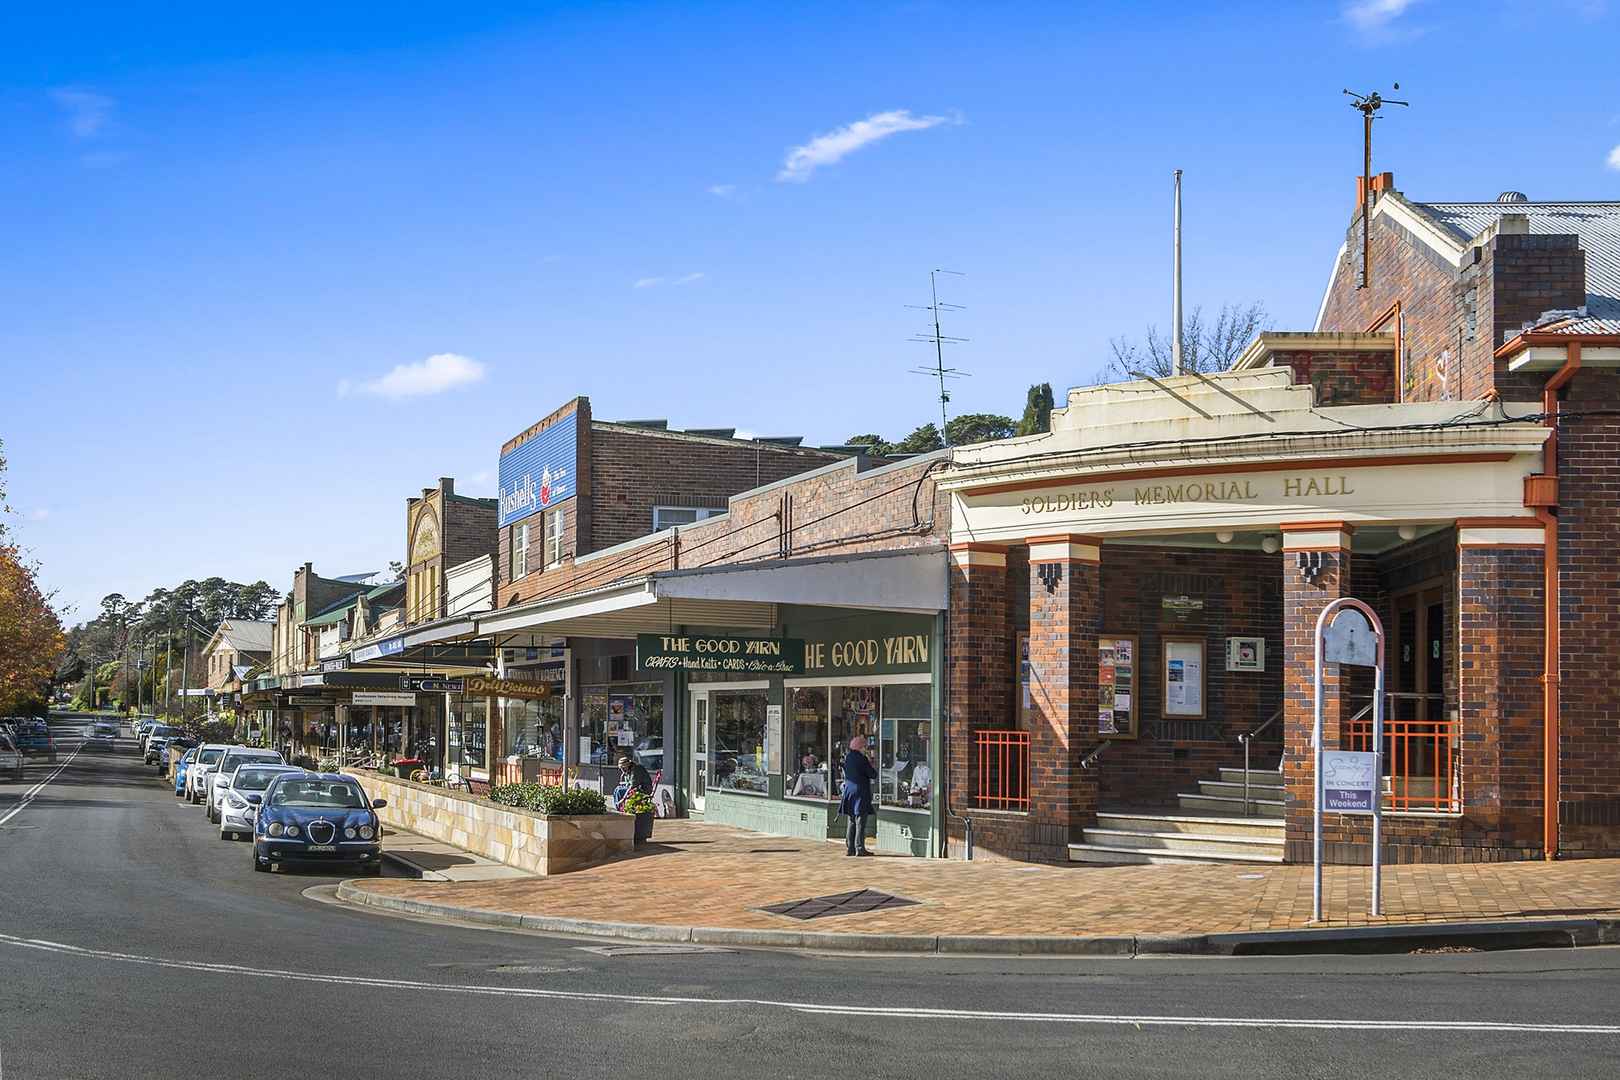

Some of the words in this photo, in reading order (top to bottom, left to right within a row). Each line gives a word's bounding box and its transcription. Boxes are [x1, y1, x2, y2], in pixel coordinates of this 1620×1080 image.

[1022, 488, 1115, 515] SOLDIERS'
[1134, 480, 1258, 506] MEMORIAL
[1283, 476, 1355, 497] HALL
[659, 637, 690, 652] THE
[695, 639, 740, 653] GOOD
[745, 640, 780, 655] YARN
[804, 643, 825, 669] HE
[831, 639, 879, 667] GOOD
[883, 634, 929, 665] YARN
[644, 656, 679, 668] CRAFTS
[683, 656, 699, 669] Hand
[723, 659, 745, 670] CARDS
[1339, 791, 1357, 799] This
[1329, 799, 1367, 808] Weekend
